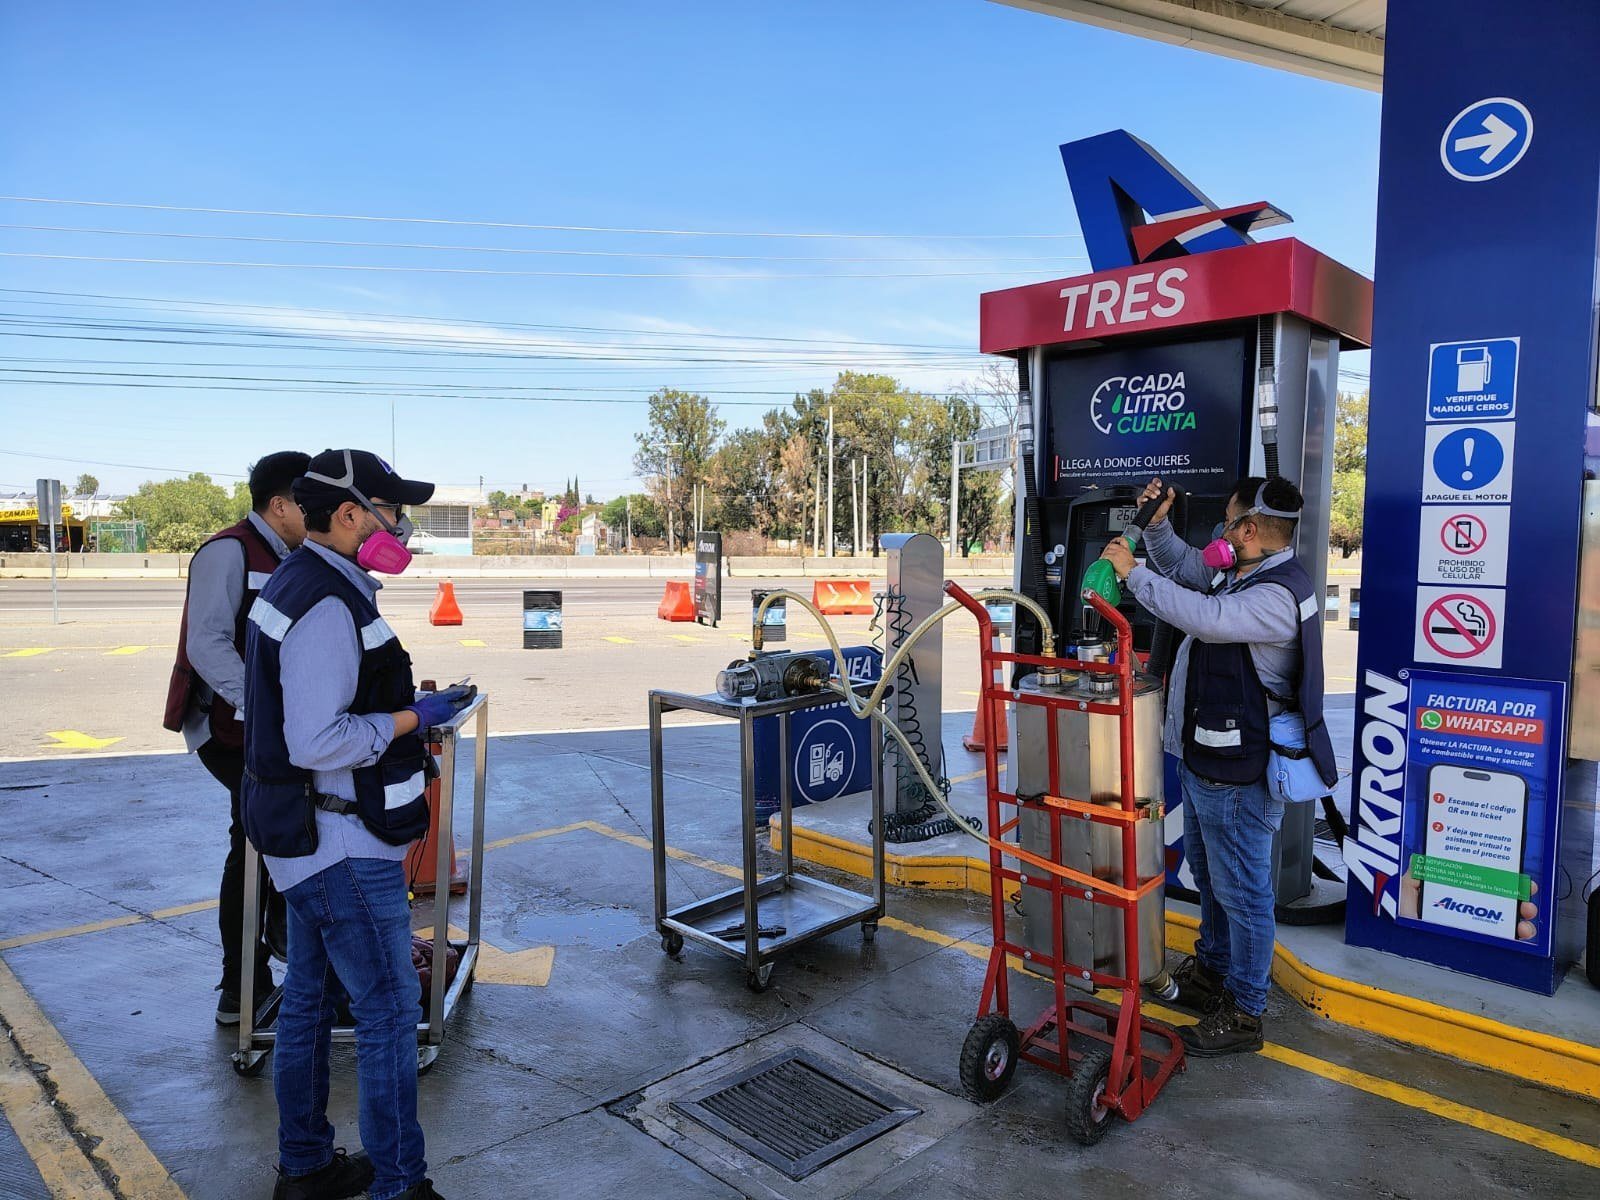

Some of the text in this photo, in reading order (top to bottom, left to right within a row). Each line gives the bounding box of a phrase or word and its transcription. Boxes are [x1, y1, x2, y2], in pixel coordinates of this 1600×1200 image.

[1060, 267, 1189, 332] TRES
[1128, 371, 1186, 394] CADA
[1123, 391, 1185, 415] LITRO
[1433, 403, 1509, 413] MARQUE CEROS
[1446, 394, 1497, 403] VERIFIQUE
[1117, 412, 1197, 434] CUENTA
[1061, 454, 1191, 470] LLEGA A DONDE QUIERES
[1439, 559, 1485, 567] PROHIBIDO
[1426, 694, 1537, 718] FACTURA POR
[1445, 715, 1537, 737] WHATSAPP
[1420, 737, 1447, 748] Obtener
[1448, 740, 1458, 749] LA
[1459, 742, 1493, 752] FACTURA
[1513, 750, 1535, 759] carga
[1432, 748, 1474, 760] combustible
[1485, 756, 1500, 764] muy
[1342, 668, 1408, 921] AKRON
[1480, 812, 1503, 821] ticket
[1445, 836, 1478, 845] asistente
[1479, 841, 1503, 850] virtual
[1453, 827, 1468, 835] deja
[1484, 833, 1512, 843] nuestro
[1481, 850, 1511, 861] proceso
[1432, 896, 1503, 921] AKRON
